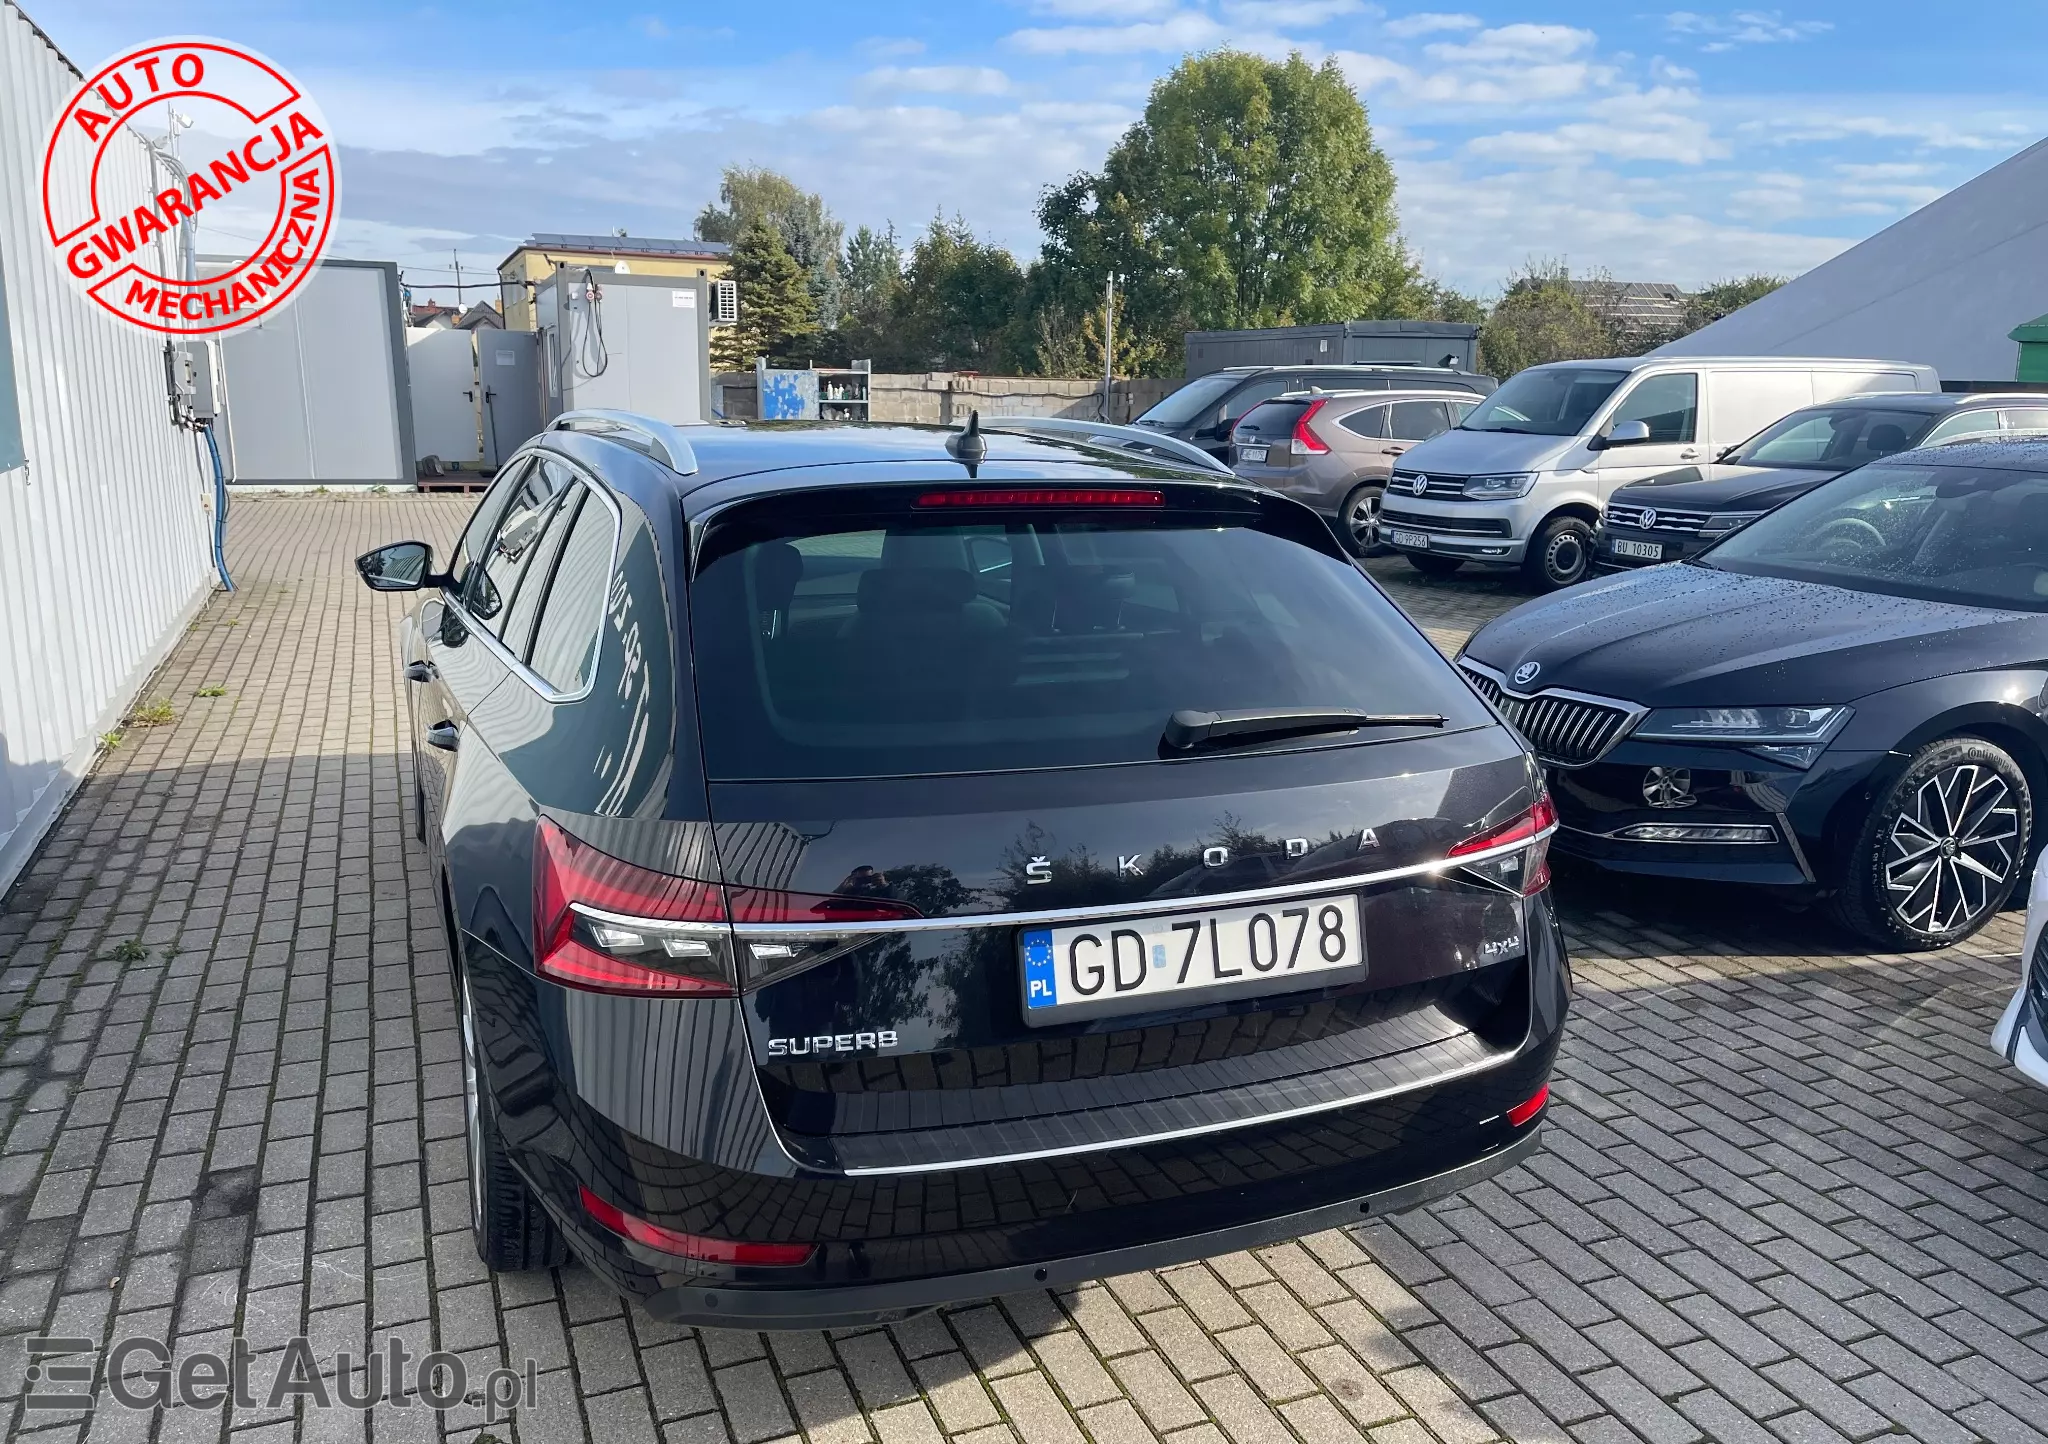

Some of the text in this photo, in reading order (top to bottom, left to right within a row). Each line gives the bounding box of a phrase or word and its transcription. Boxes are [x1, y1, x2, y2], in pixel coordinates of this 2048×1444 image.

[1617, 540, 1659, 558] BU 10305
[1967, 746, 2012, 770] Continental
[1069, 904, 1346, 996] GD 7L078
[1030, 979, 1052, 998] PL
[768, 1030, 897, 1056] SUPERB
